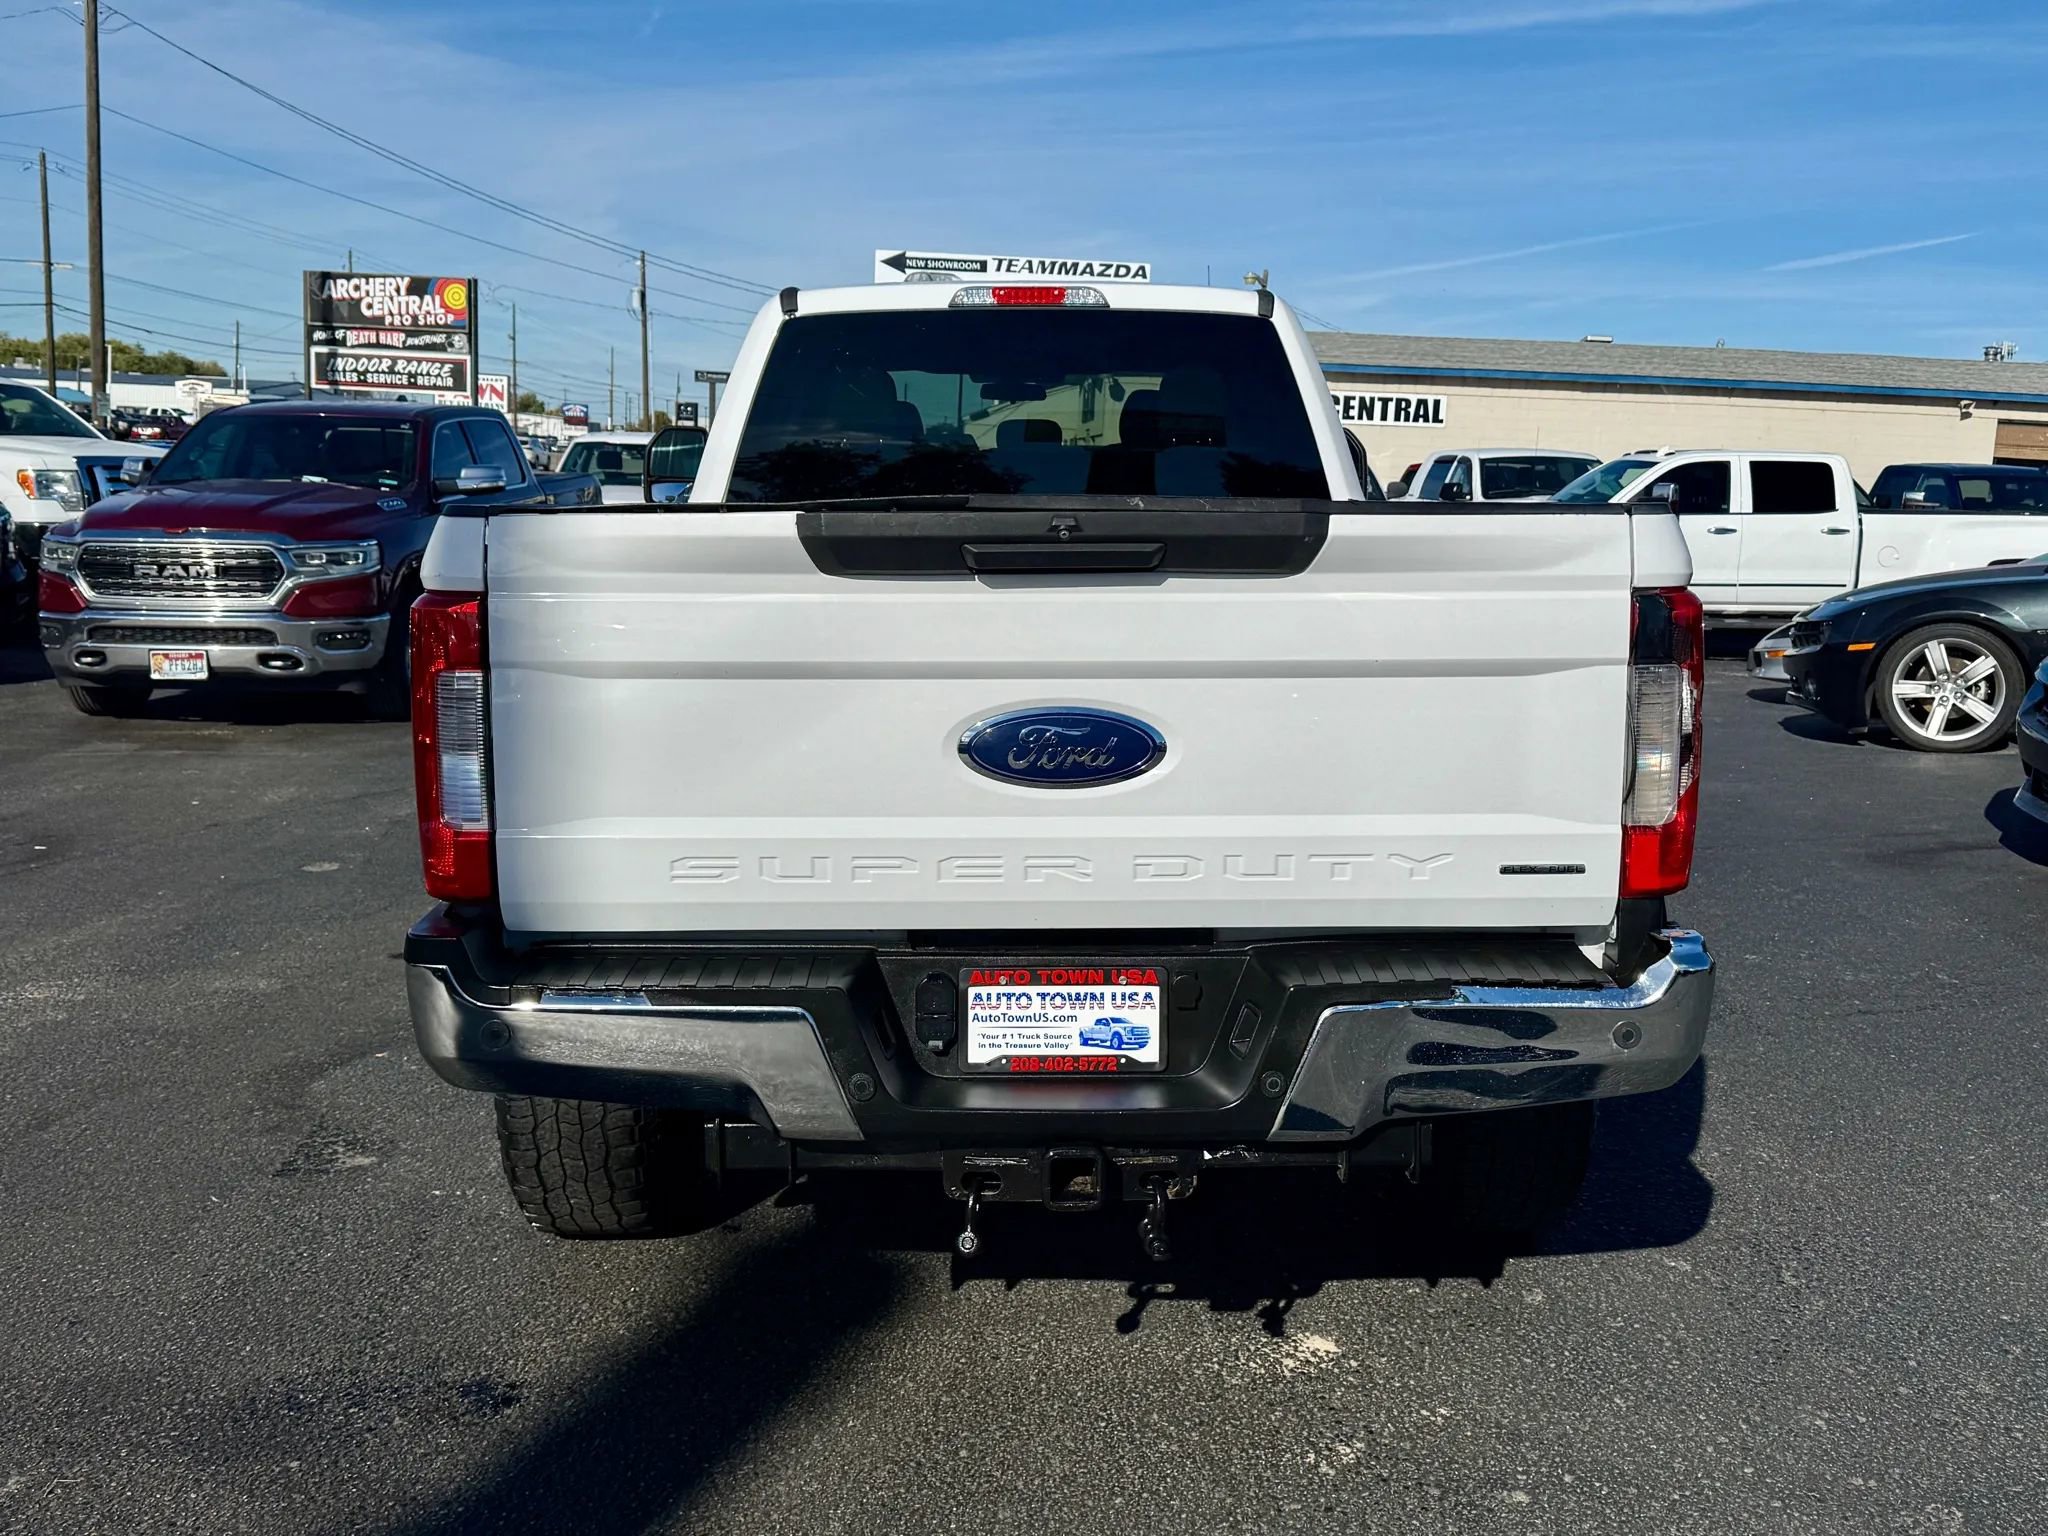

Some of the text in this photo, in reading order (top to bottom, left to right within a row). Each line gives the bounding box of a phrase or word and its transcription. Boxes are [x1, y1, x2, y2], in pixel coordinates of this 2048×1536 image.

[906, 259, 981, 271] NEW SHOWROOM
[322, 277, 411, 299] ARCHERY
[360, 295, 446, 318] CENTRAL
[385, 314, 454, 326] PRO SHOP
[335, 329, 346, 341] OF
[346, 330, 377, 347] DEATH
[326, 357, 453, 377] INDOOR RANGE
[327, 371, 454, 387] SALES SERVICE REPAIR
[133, 564, 217, 578] RAM
[1007, 725, 1117, 770] Ford
[670, 853, 1455, 884] SUPER DUTY
[968, 969, 1158, 986] AUTO TOWN USA
[970, 991, 1157, 1011] AUTO TOWN USA
[971, 1012, 1078, 1024] AutoTownUS.com
[1010, 1057, 1118, 1072] 208-402-5772
